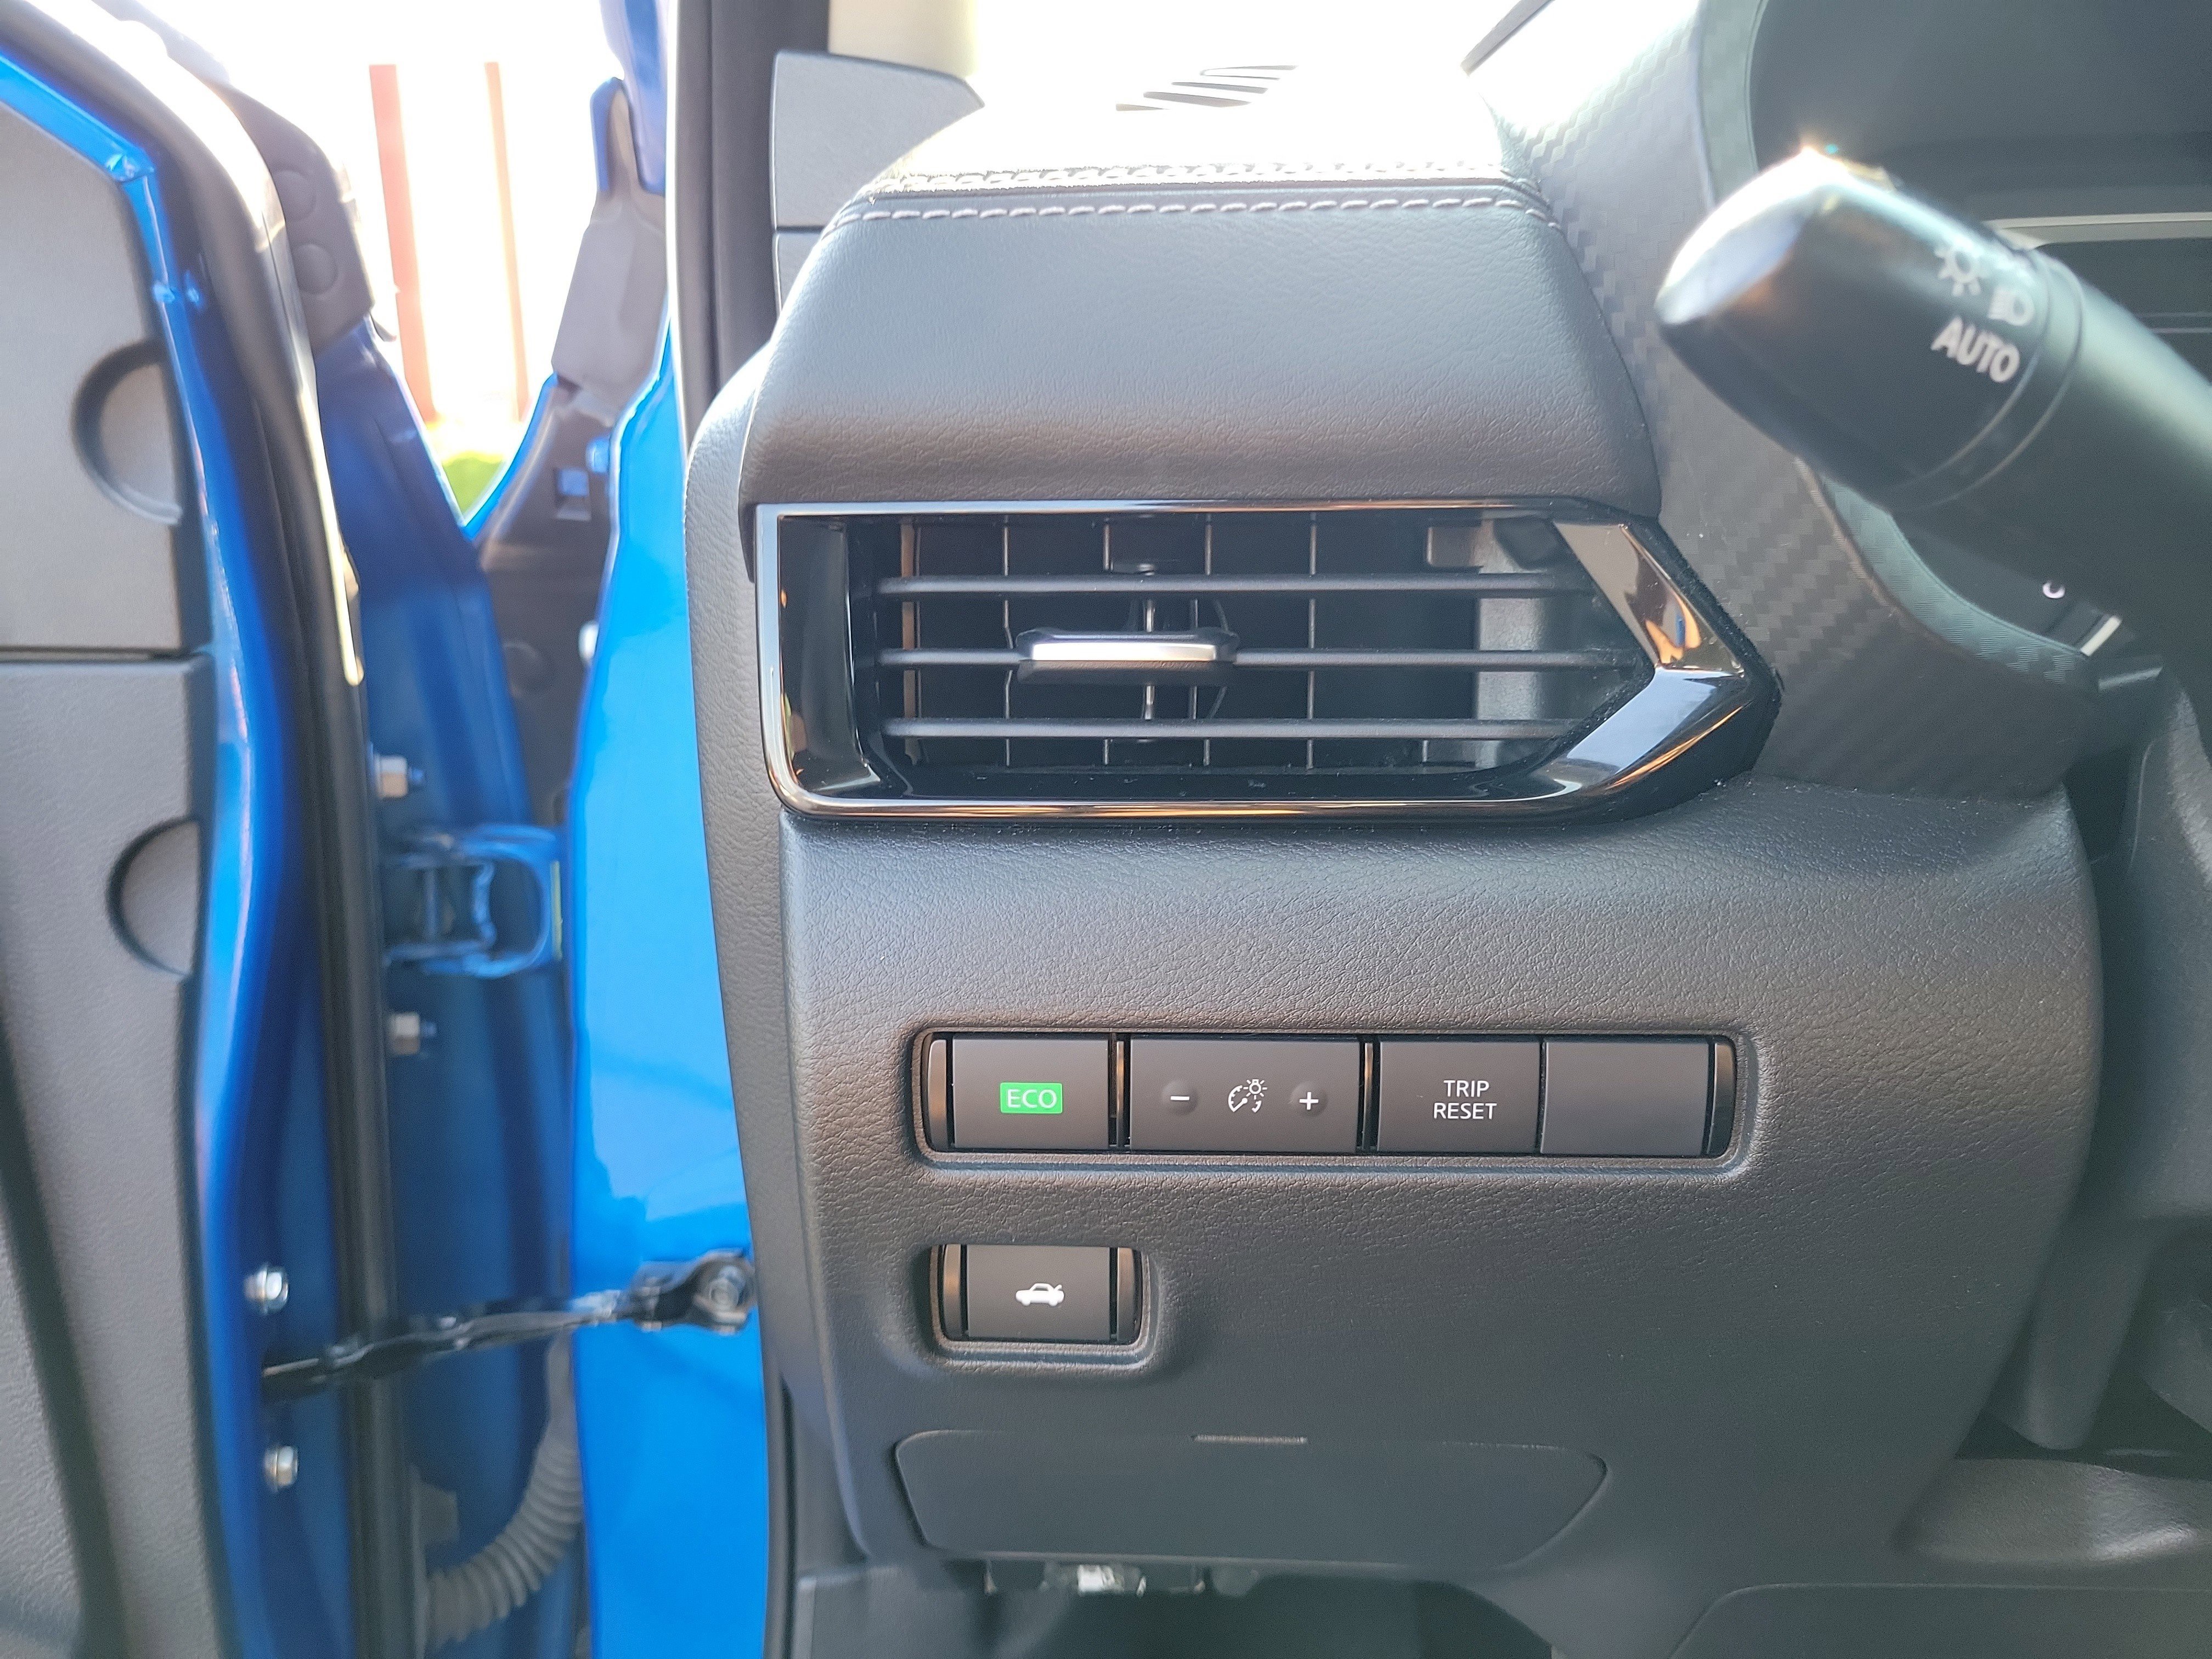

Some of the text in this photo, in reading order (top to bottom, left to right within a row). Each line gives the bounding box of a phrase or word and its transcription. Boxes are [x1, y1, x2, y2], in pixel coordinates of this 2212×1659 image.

[1931, 317, 2021, 383] AUTO
[1006, 1088, 1058, 1109] ECO
[1442, 1079, 1490, 1098] TRIP
[1433, 1102, 1498, 1120] RESET
